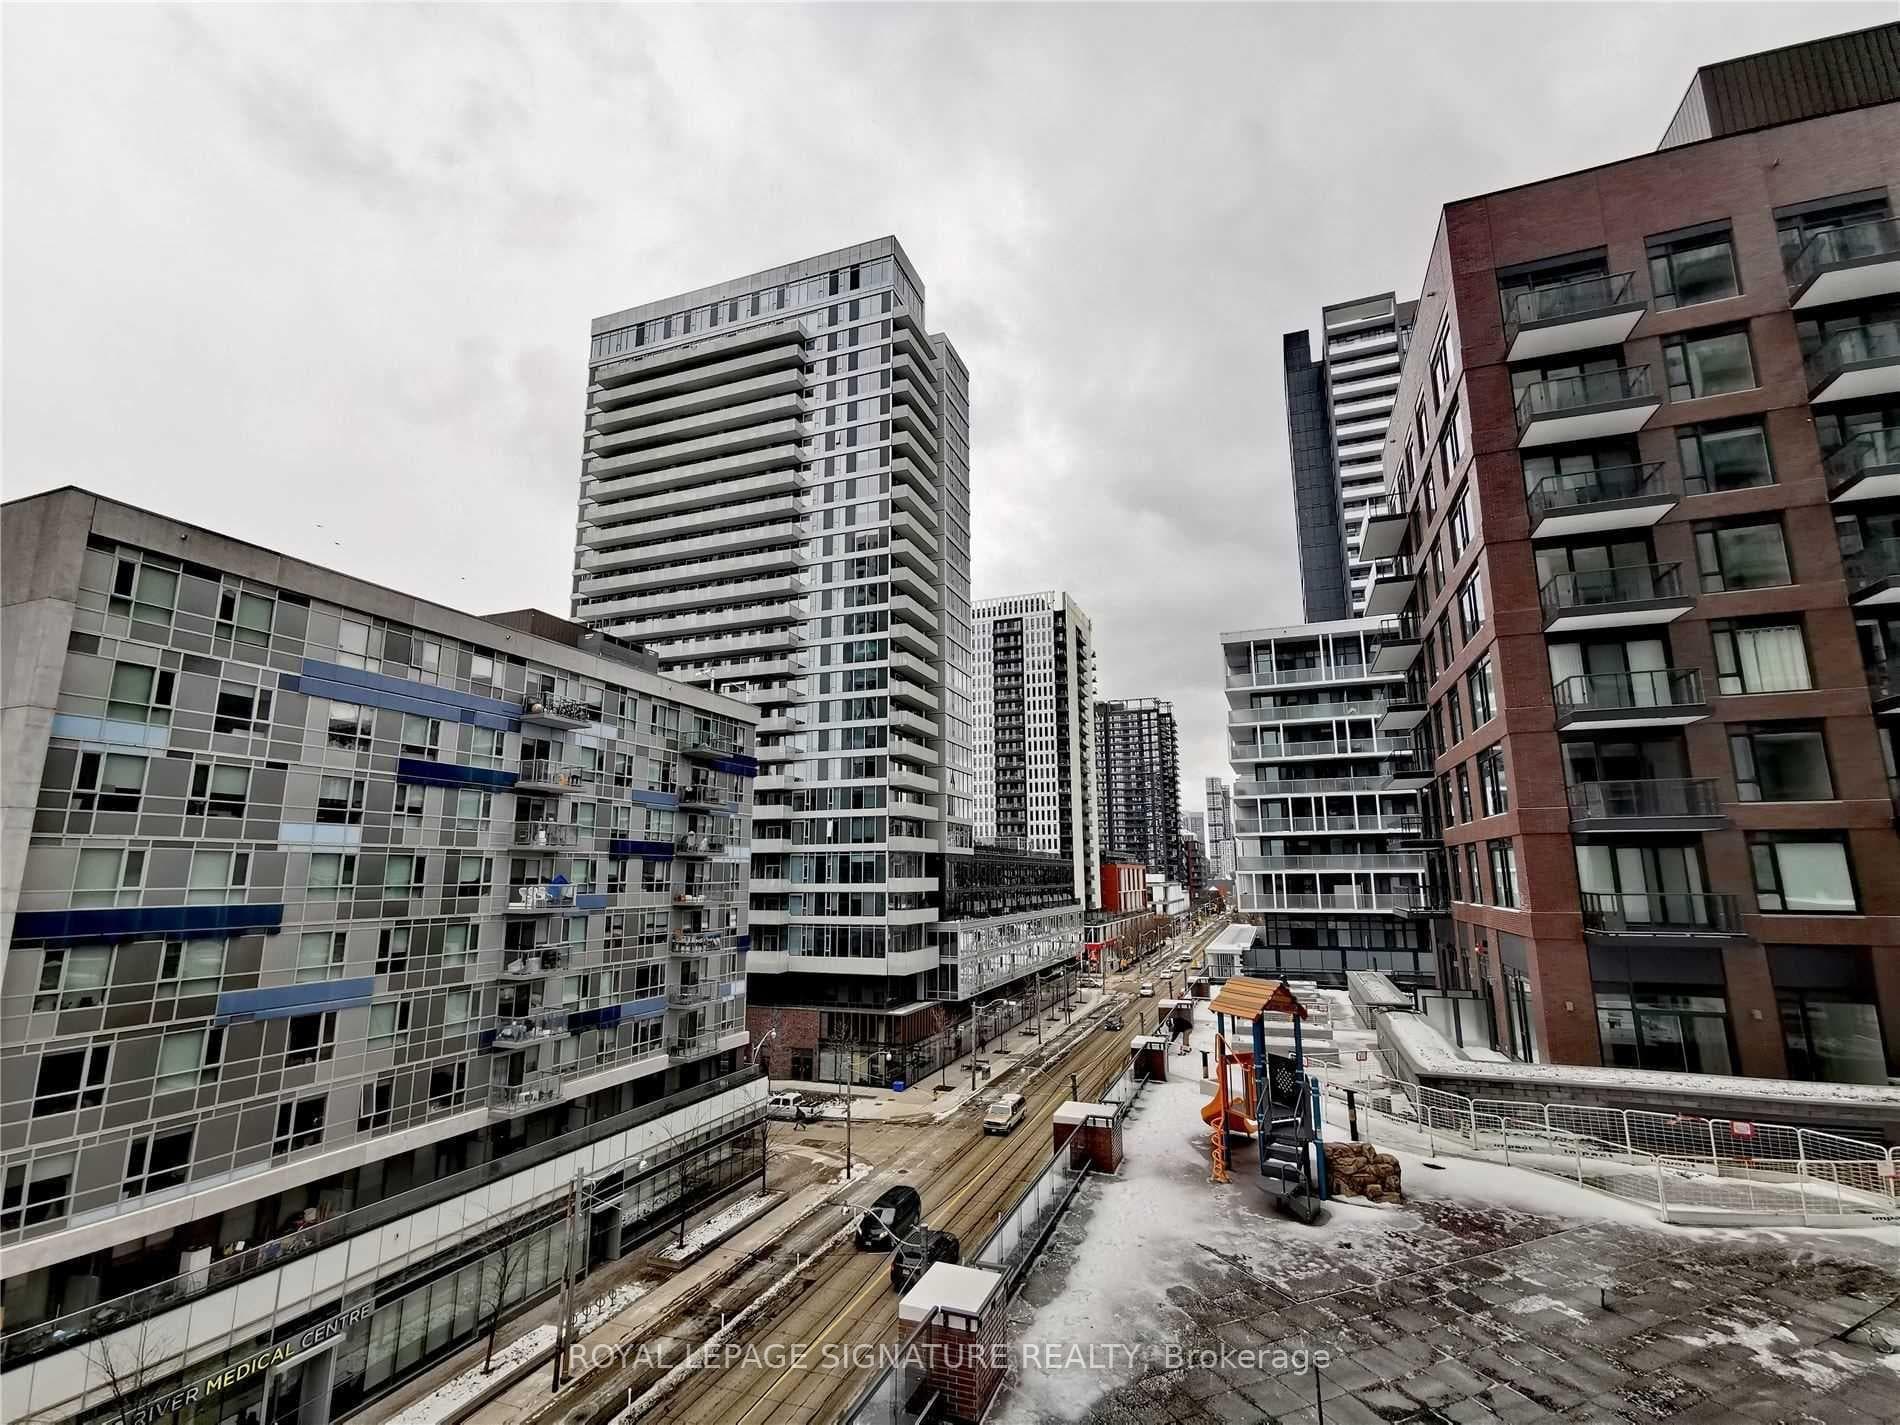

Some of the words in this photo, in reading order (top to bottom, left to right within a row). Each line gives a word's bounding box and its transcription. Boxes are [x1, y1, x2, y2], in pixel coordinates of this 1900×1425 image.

[135, 1388, 198, 1425] RIVER
[205, 1343, 296, 1396] MEDICAL
[301, 1303, 371, 1348] CENTRE
